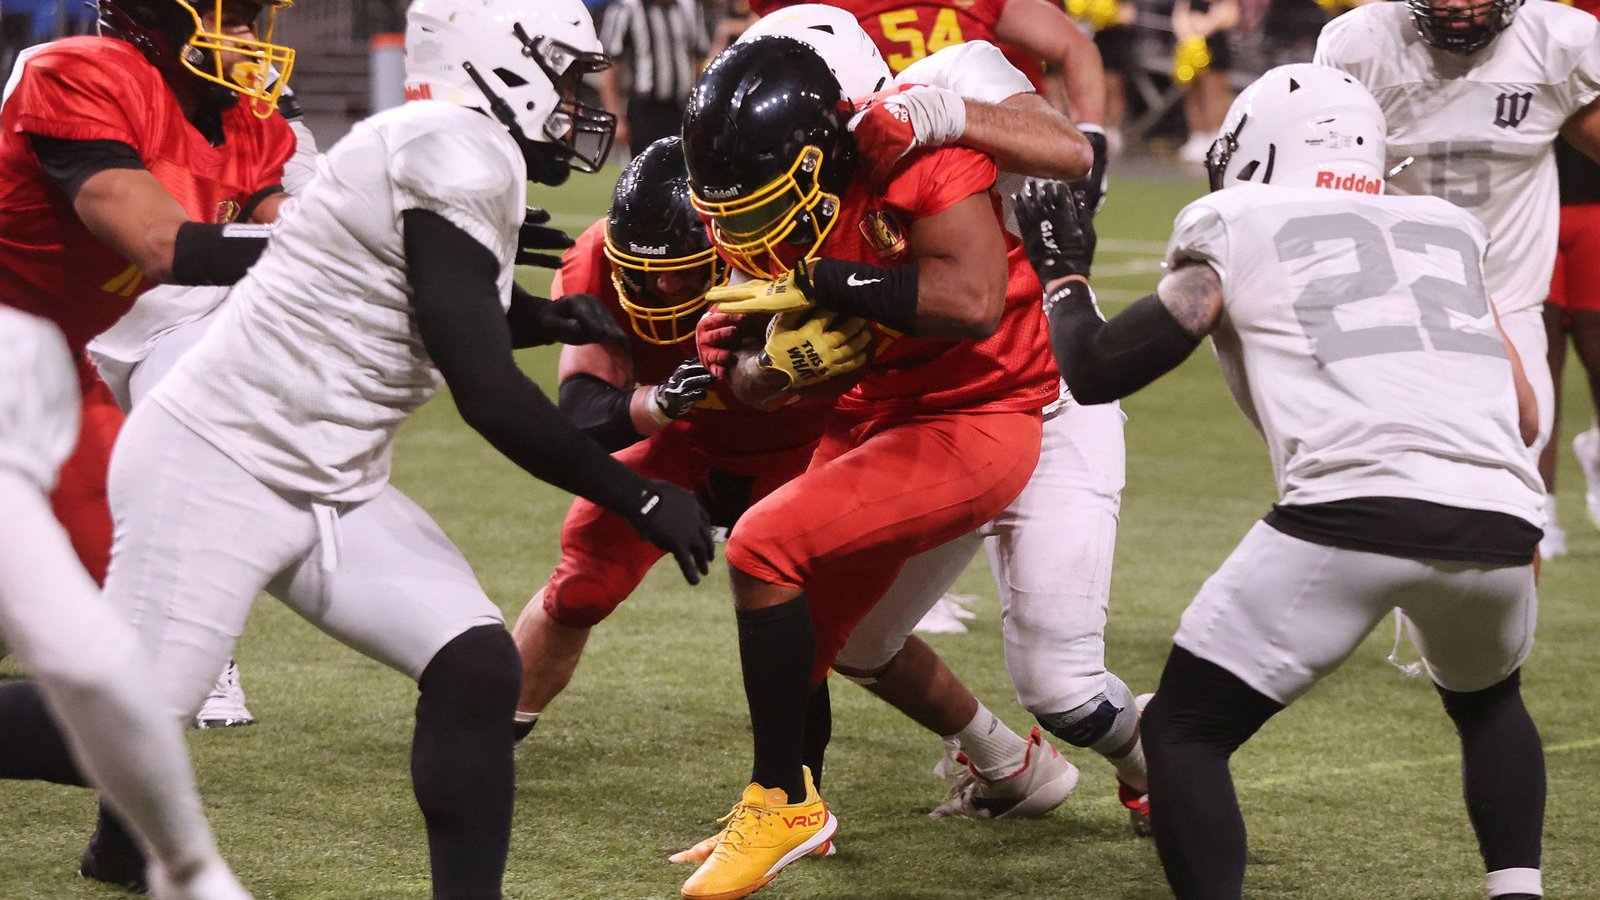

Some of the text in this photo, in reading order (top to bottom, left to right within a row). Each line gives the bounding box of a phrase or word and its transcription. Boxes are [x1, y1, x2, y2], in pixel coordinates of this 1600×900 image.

[879, 8, 964, 72] 54
[1427, 140, 1493, 208] 15
[703, 187, 739, 199] Riddell
[630, 243, 667, 255] Riddell
[1273, 211, 1510, 364] 22
[801, 340, 824, 367] THIS
[782, 811, 823, 829] VRLT
